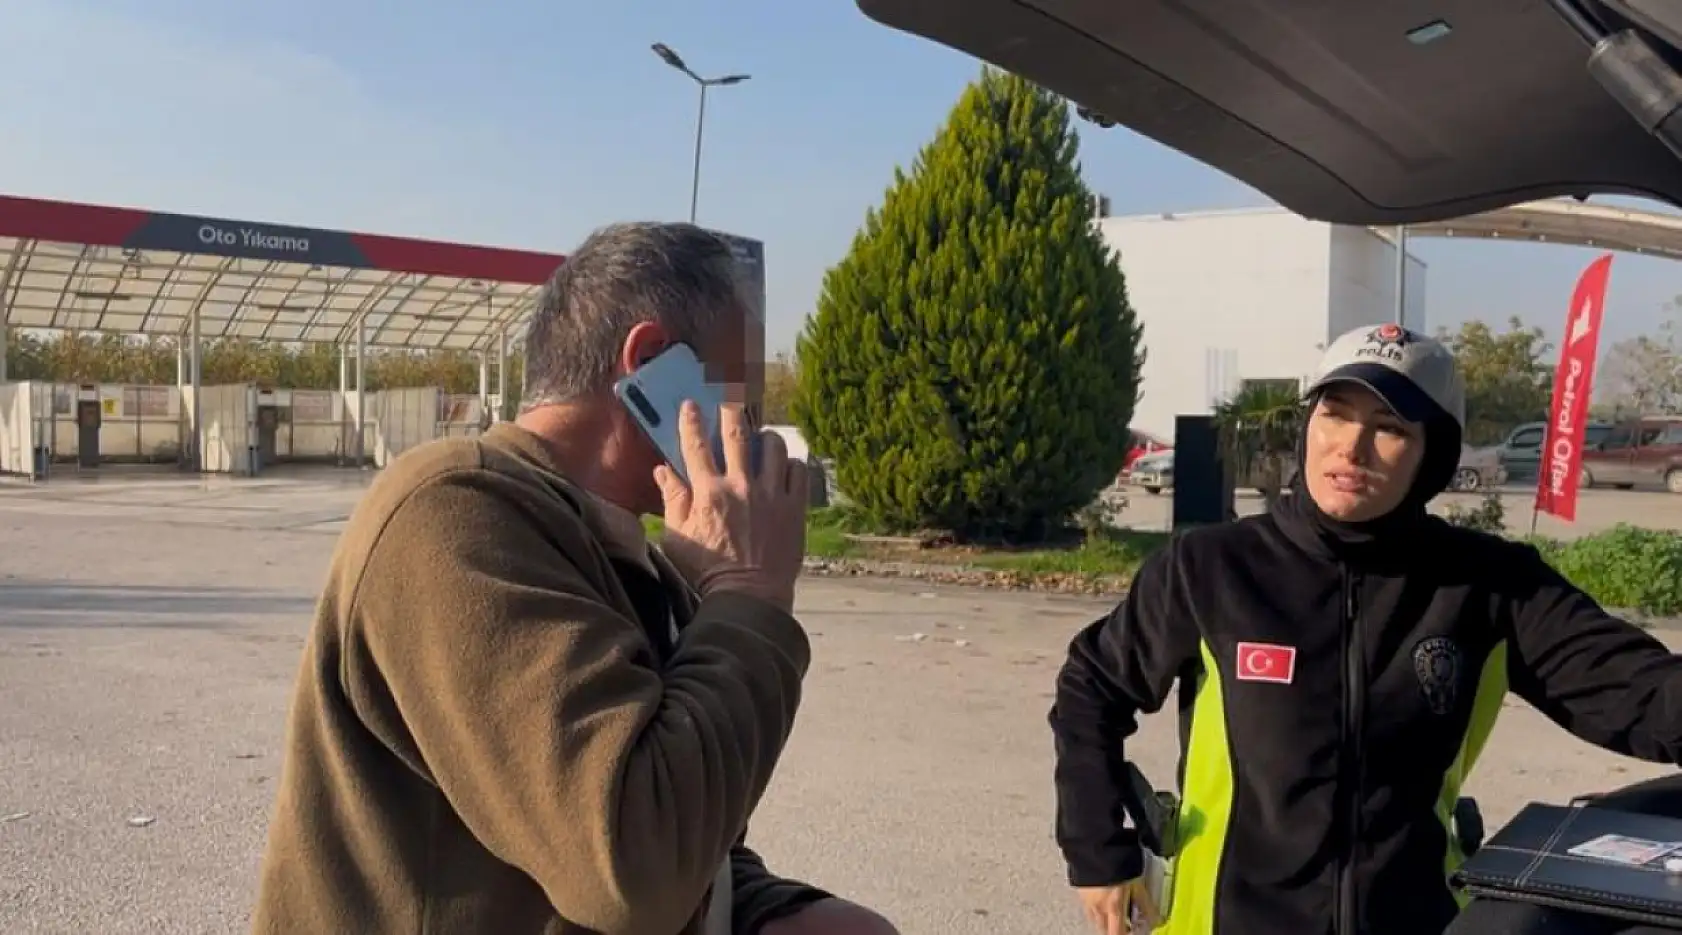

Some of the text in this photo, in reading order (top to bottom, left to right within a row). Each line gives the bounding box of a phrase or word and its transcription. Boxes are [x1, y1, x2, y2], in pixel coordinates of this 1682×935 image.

[199, 226, 309, 251] Oto Yıkama
[1558, 359, 1582, 433] Petrol
